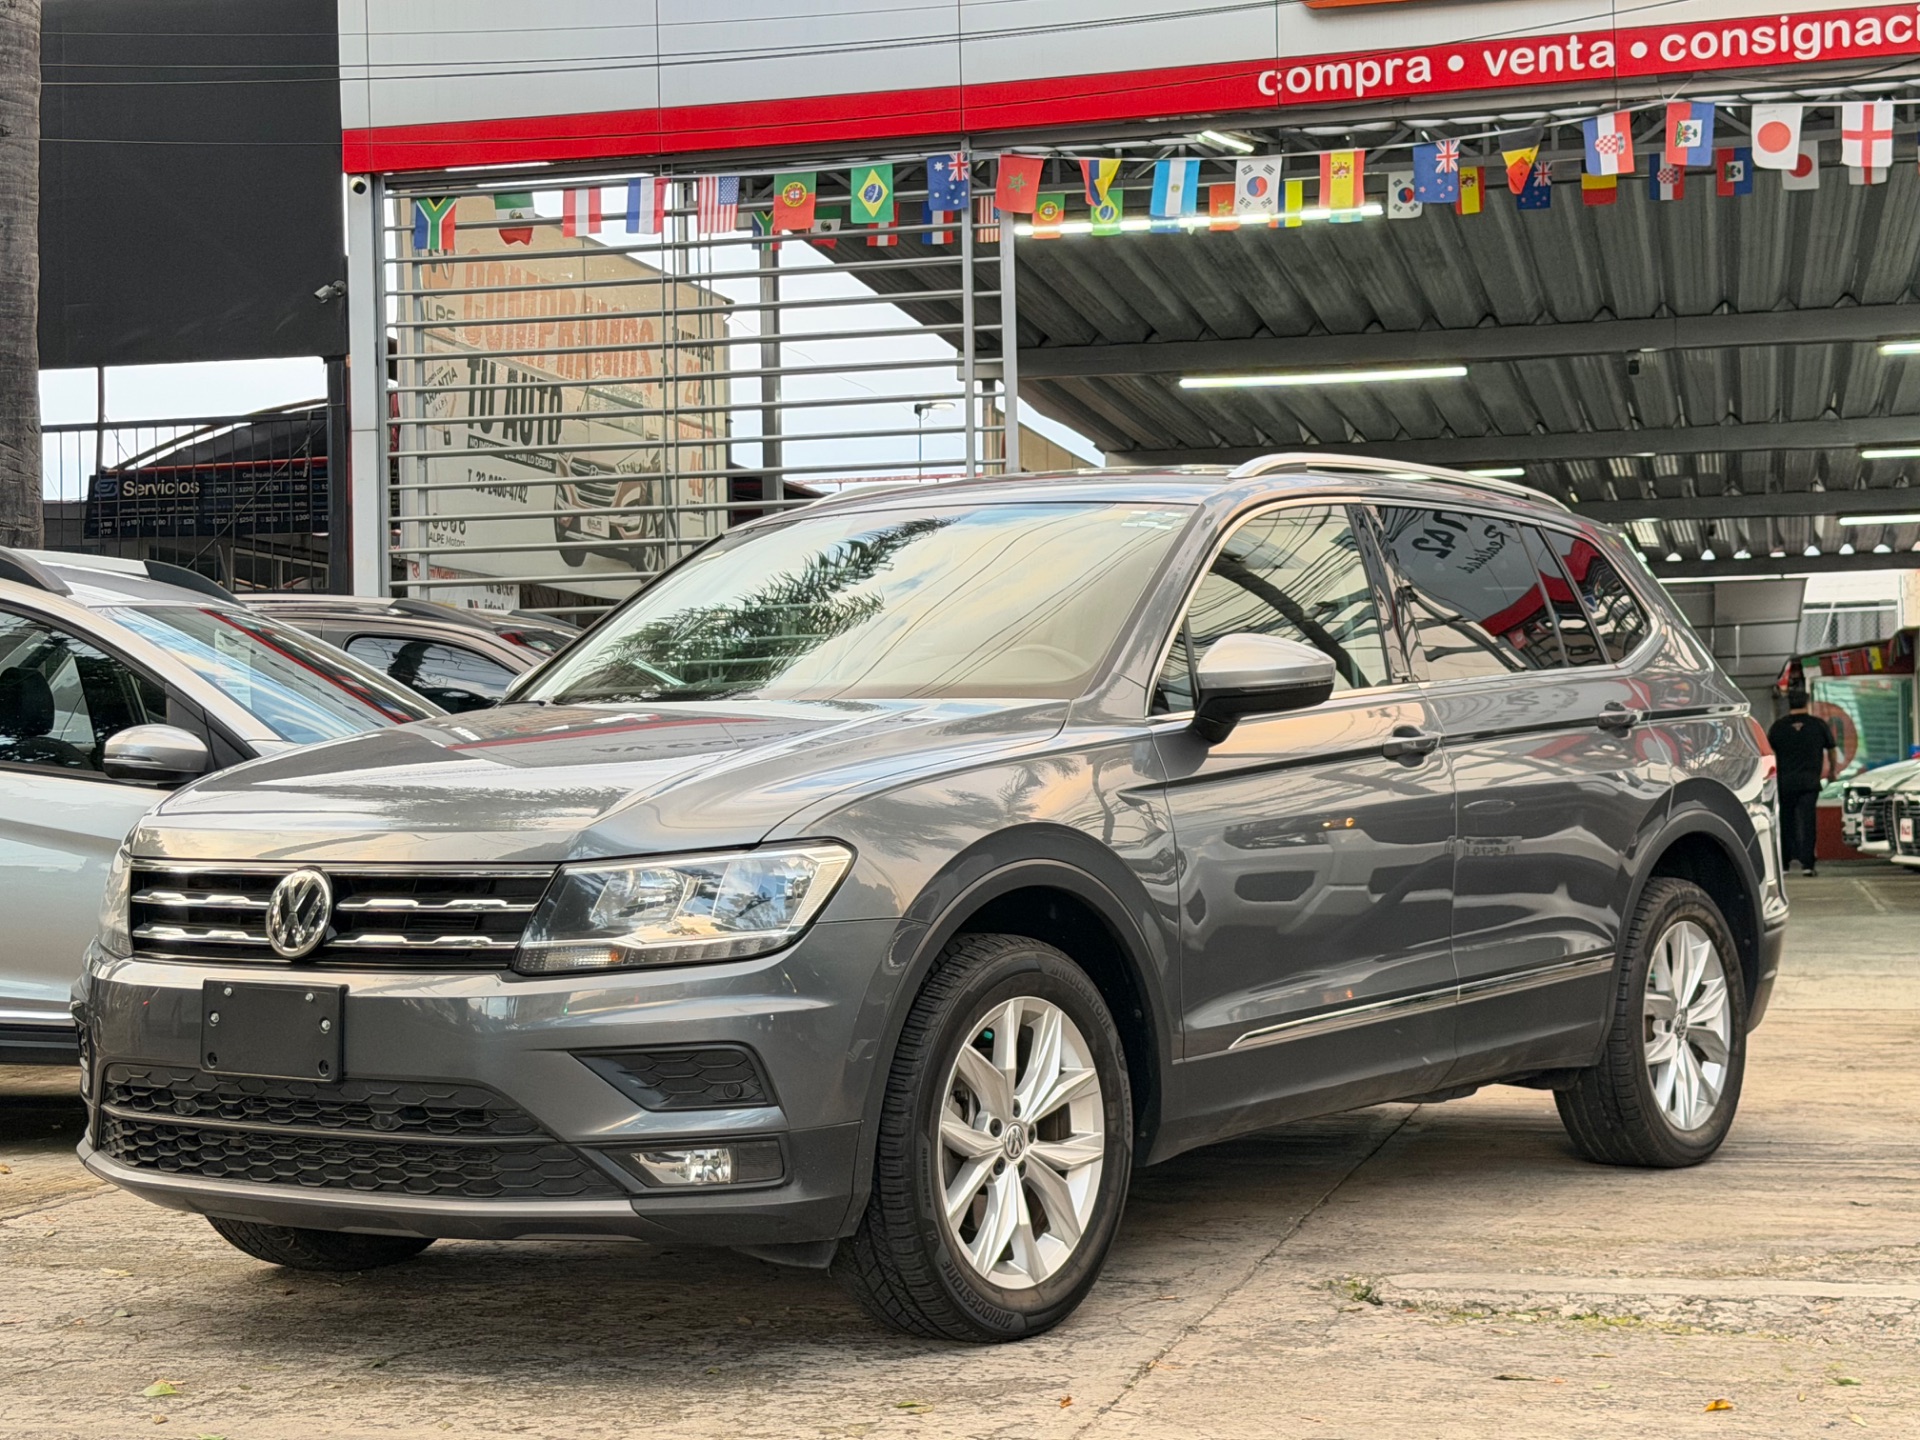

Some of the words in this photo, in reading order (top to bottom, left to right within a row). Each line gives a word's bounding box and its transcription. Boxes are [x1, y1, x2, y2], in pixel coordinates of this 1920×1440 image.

[1257, 55, 1431, 97] compra
[1482, 35, 1616, 77] venta
[466, 358, 496, 434] TU
[502, 367, 562, 446] AUTO
[123, 479, 200, 496] Servicios
